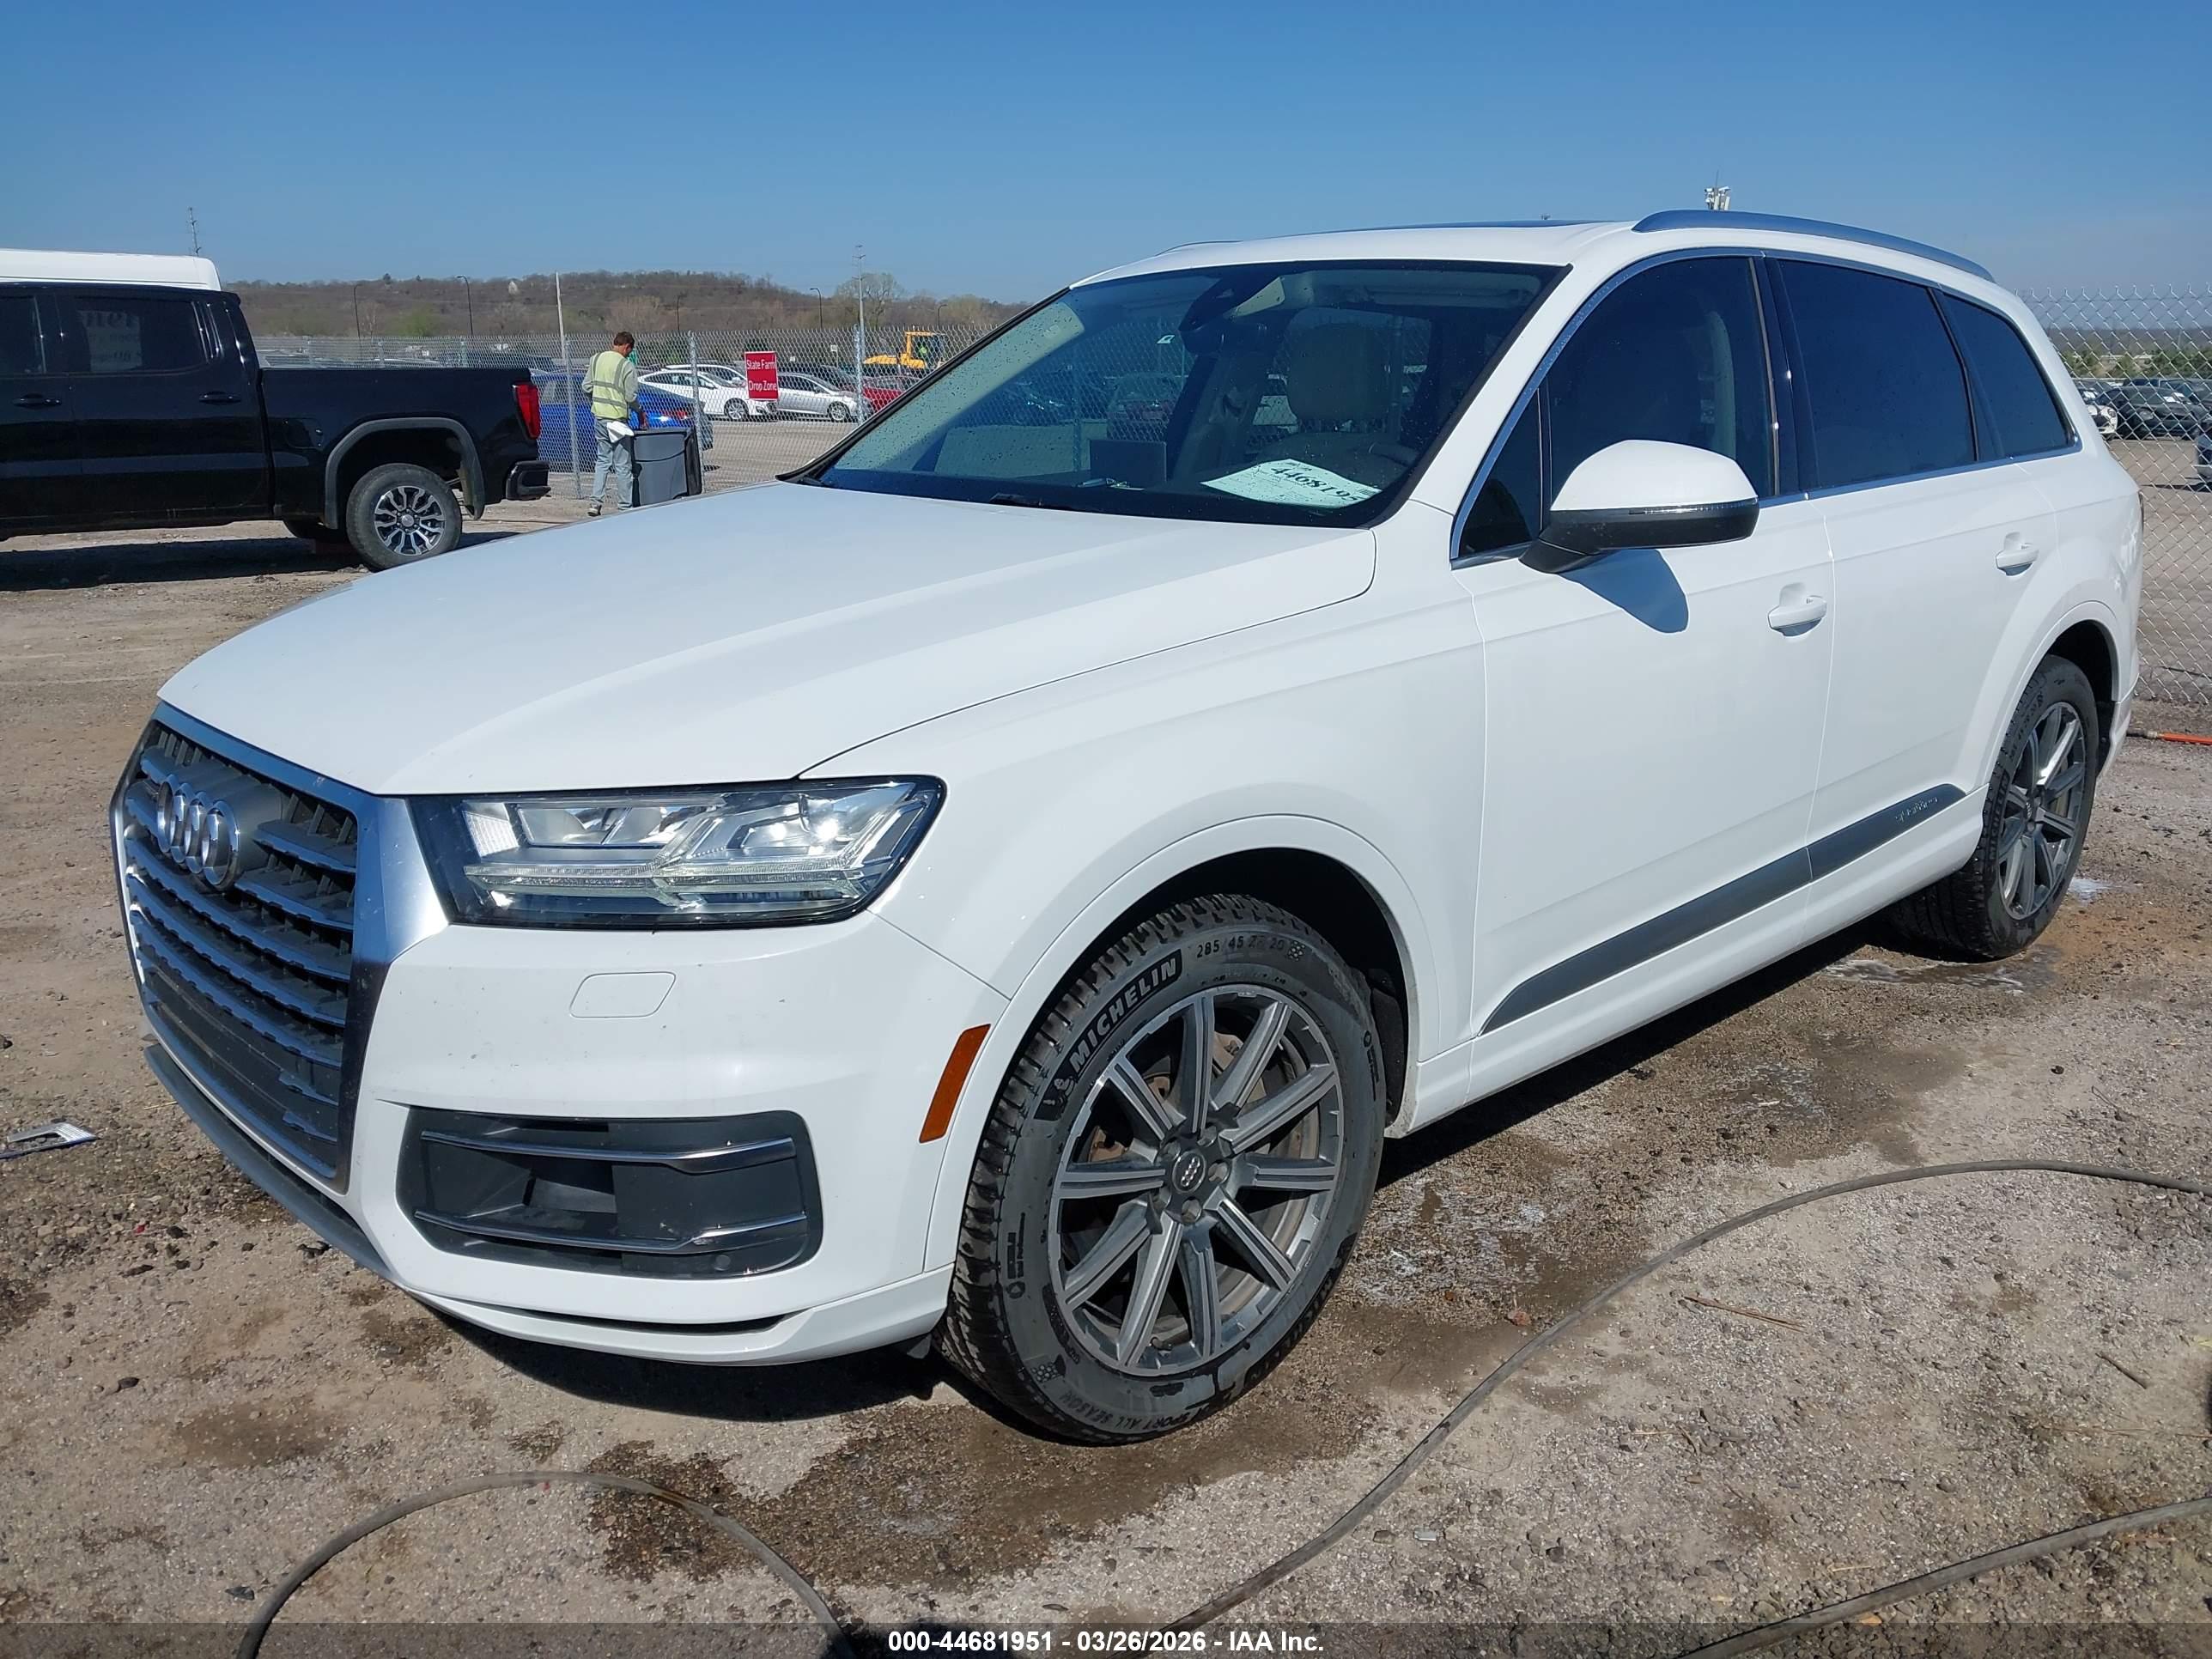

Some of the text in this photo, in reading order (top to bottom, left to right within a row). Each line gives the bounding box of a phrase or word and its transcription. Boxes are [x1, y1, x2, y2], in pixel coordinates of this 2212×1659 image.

[747, 359, 776, 370] State Farm
[748, 380, 777, 392] Drop Zone
[1196, 939, 1219, 958] 285
[1068, 957, 1176, 1074] MICHELIN
[1058, 1389, 1114, 1425] SEASON
[1115, 1416, 1142, 1430] ALL
